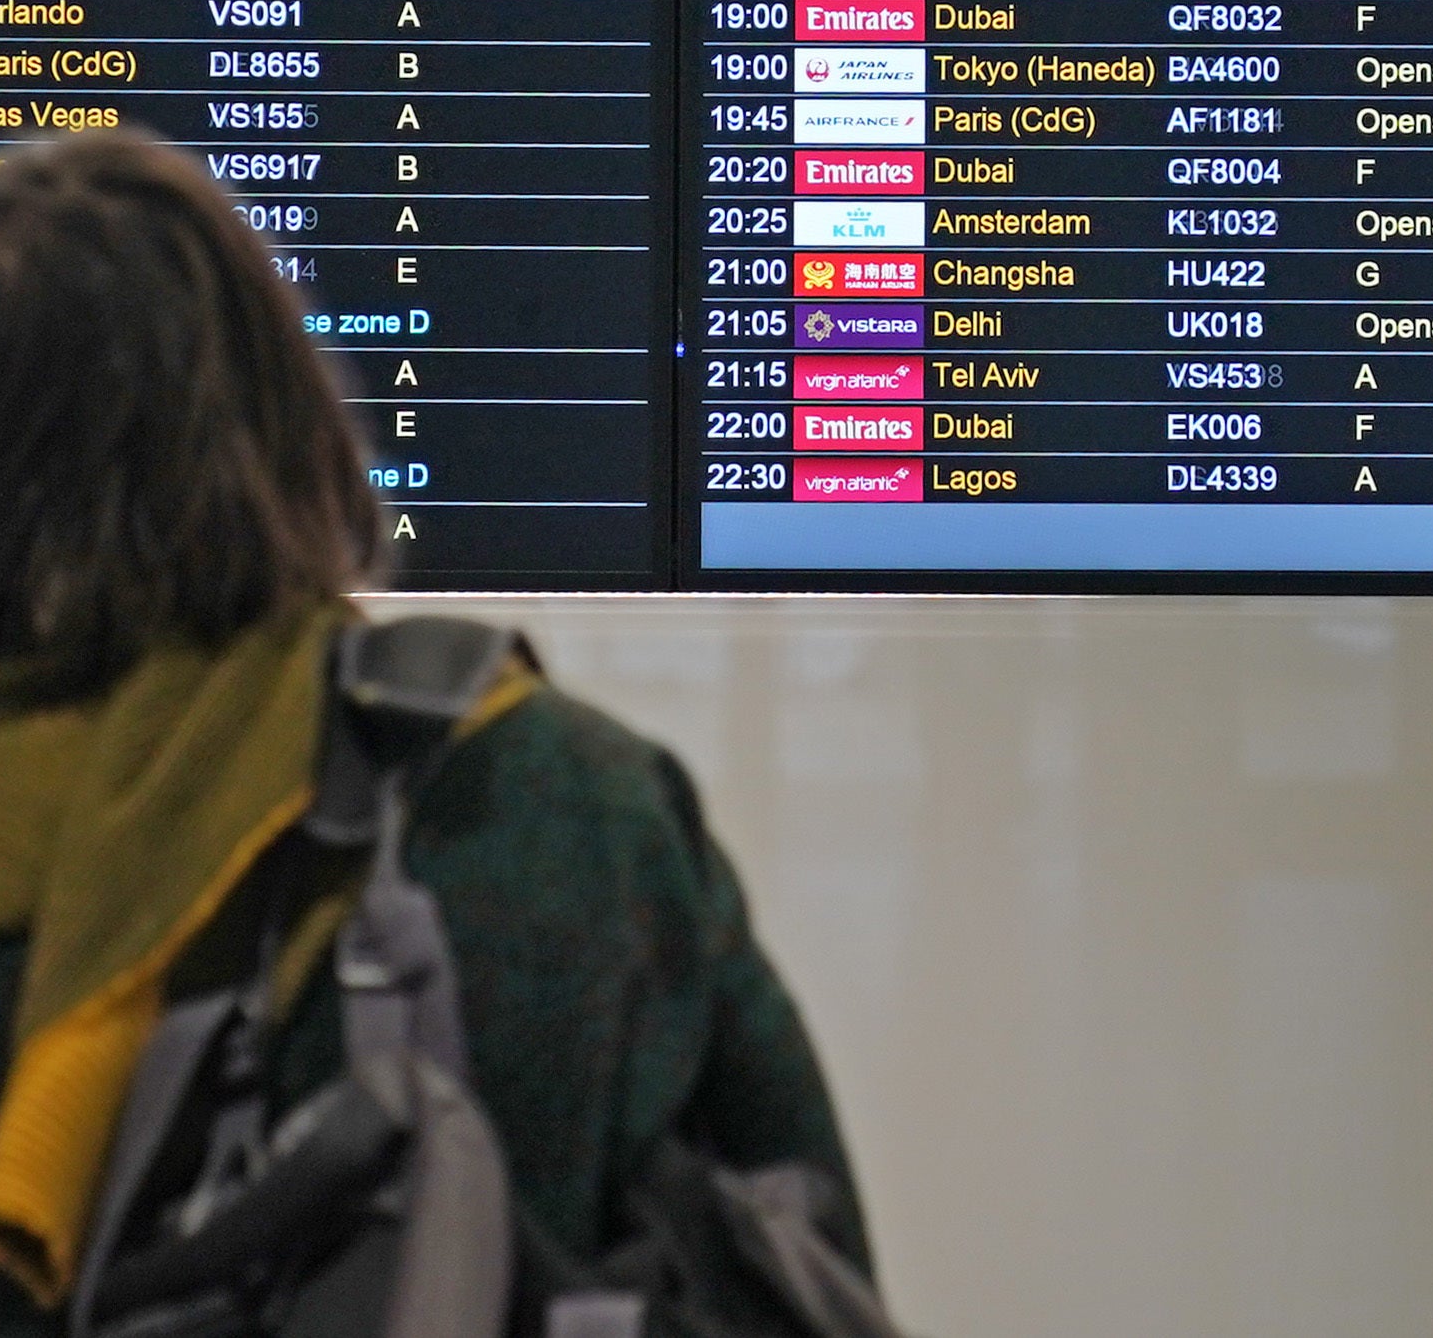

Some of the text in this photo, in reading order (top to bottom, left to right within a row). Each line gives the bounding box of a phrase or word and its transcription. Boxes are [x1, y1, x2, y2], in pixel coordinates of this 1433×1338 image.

[708, 259, 1379, 291] 21:00 Changsha HU422 G
[845, 263, 915, 280] 海南航空
[708, 310, 786, 335] 21:05
[934, 311, 1001, 336] Delhi
[1168, 312, 1263, 337] UK018
[708, 412, 1374, 440] 22:00 Emirates Dubai EK006 F
